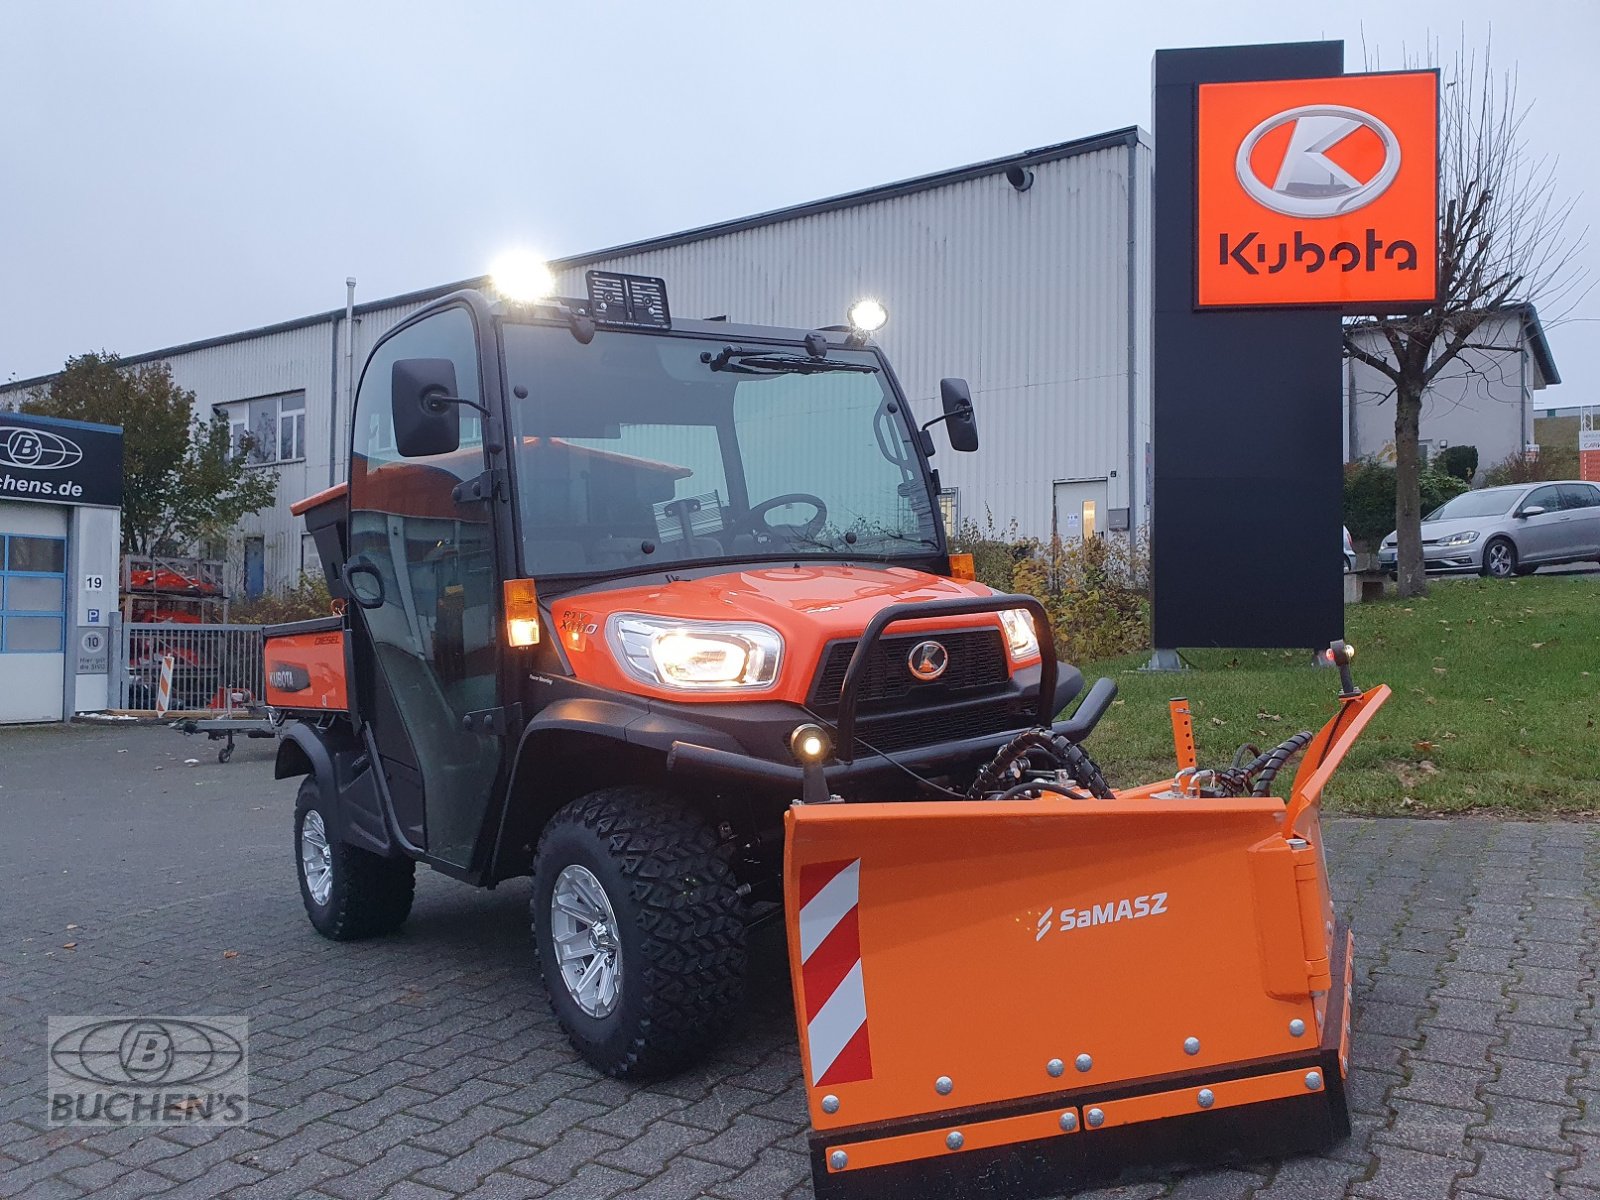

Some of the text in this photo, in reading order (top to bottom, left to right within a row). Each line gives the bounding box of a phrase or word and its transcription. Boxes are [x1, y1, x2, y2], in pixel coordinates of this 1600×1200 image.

[1219, 229, 1417, 275] Kubota
[0, 474, 83, 497] hens.de
[86, 577, 102, 589] 19
[89, 610, 98, 621] P
[87, 637, 99, 648] 10
[269, 670, 294, 688] KUBOTA
[1060, 892, 1168, 931] SaMASZ
